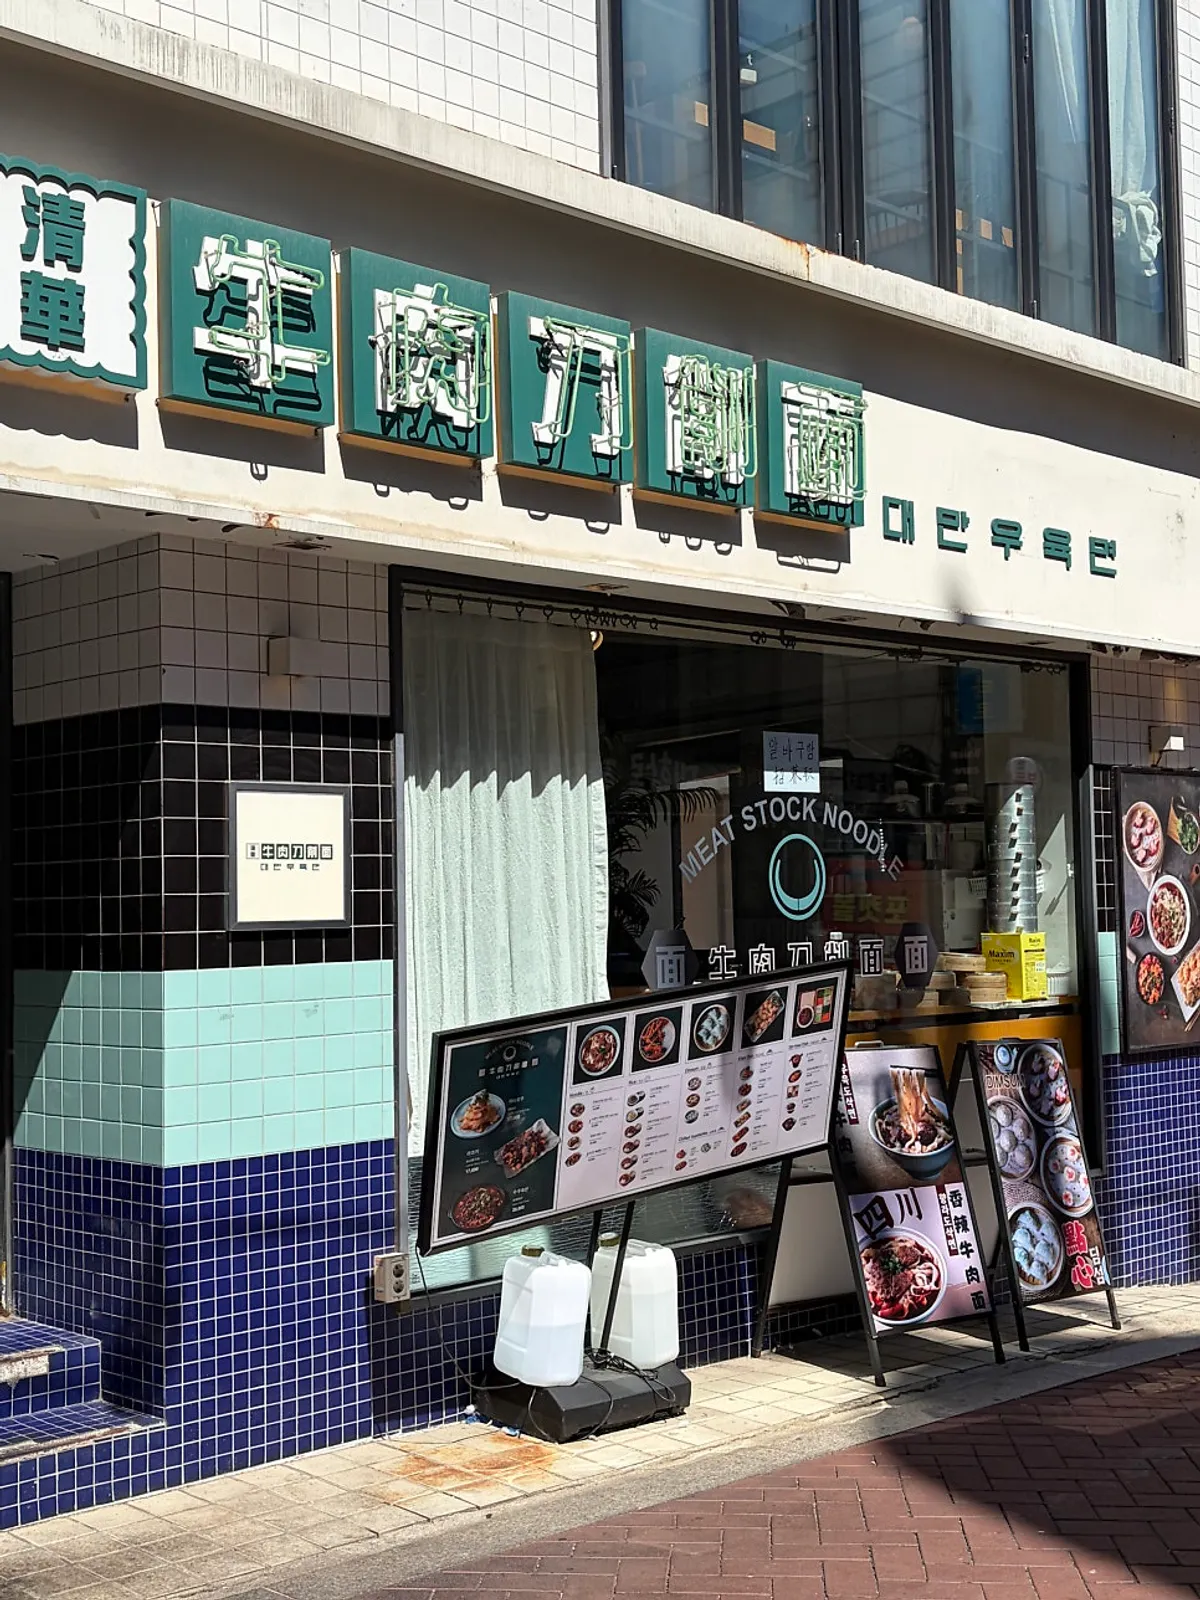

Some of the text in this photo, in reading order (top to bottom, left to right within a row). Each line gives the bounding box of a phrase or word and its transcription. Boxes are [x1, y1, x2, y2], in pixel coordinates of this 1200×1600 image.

[20, 185, 86, 352] 清華
[882, 495, 1118, 578] 대만우육면
[679, 796, 905, 884] MEAT STOCK NOODLE
[987, 946, 1015, 959] Maxim
[853, 1187, 923, 1240] 四川
[948, 1188, 986, 1311] 香辣牛肉面
[1089, 1245, 1107, 1286] 딤섬
